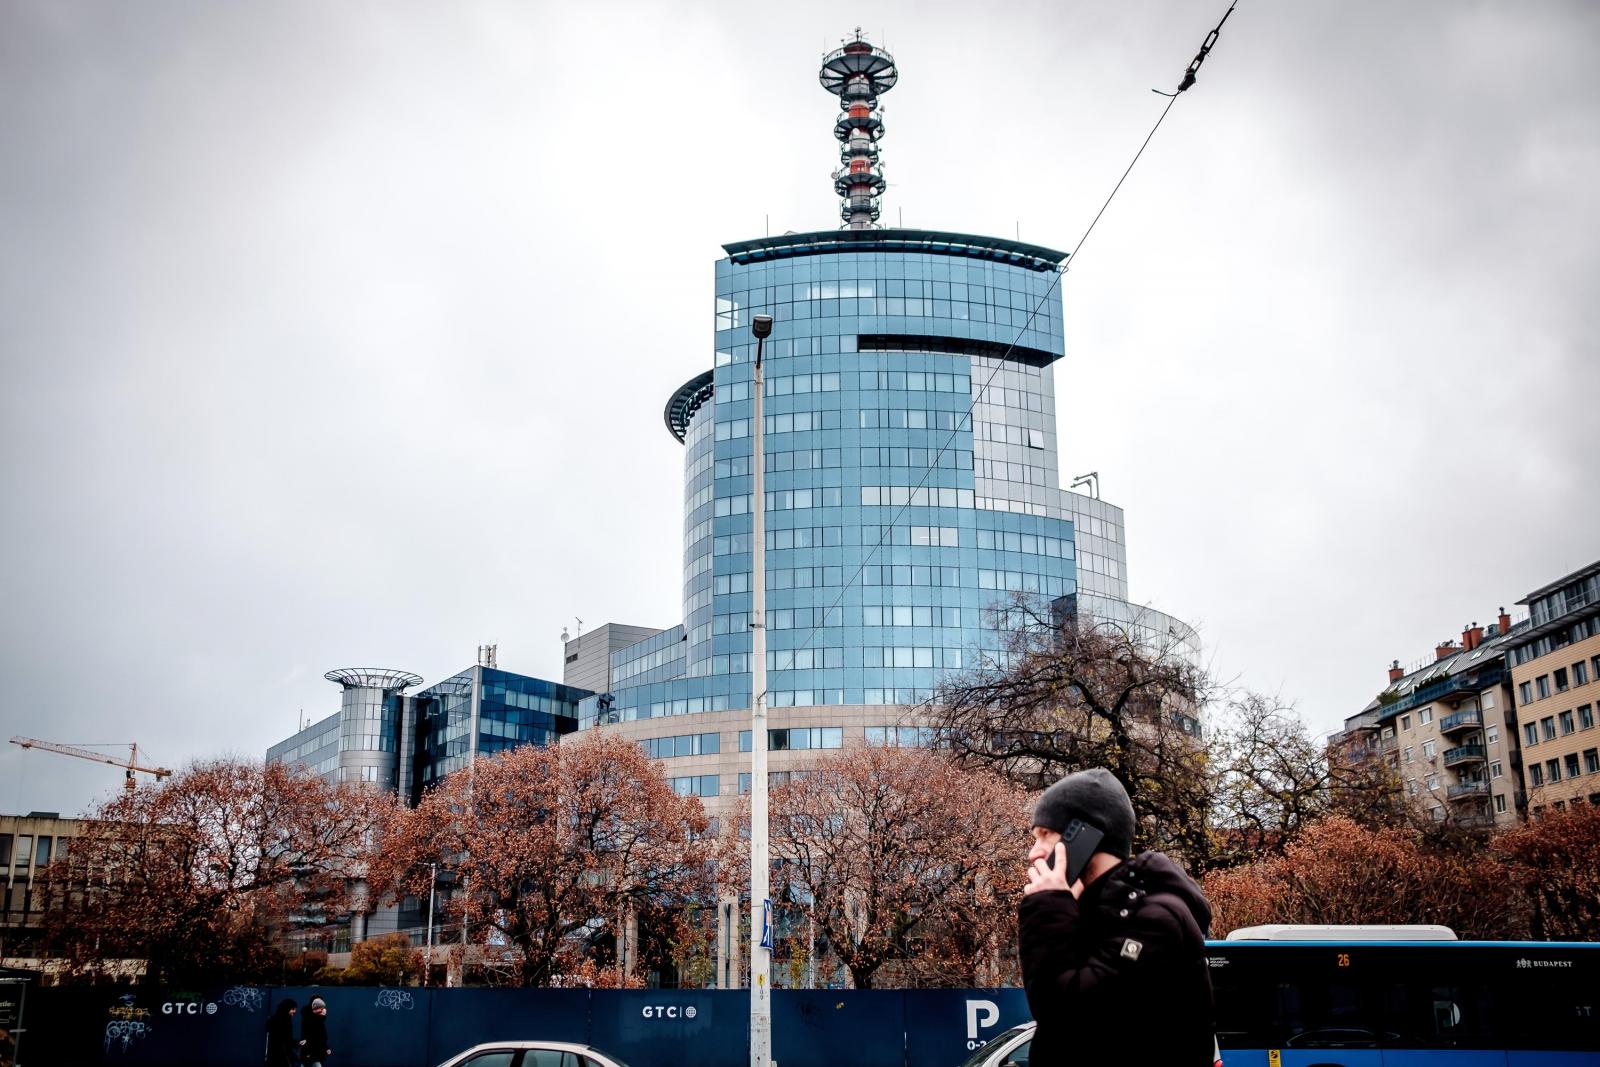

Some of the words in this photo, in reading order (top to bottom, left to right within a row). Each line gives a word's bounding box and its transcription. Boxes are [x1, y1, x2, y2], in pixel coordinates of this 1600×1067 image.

[1337, 953, 1350, 967] 26
[1533, 960, 1573, 968] BUDAPEST
[161, 1002, 198, 1015] GTC
[642, 1006, 677, 1018] GTC
[966, 999, 1000, 1039] P
